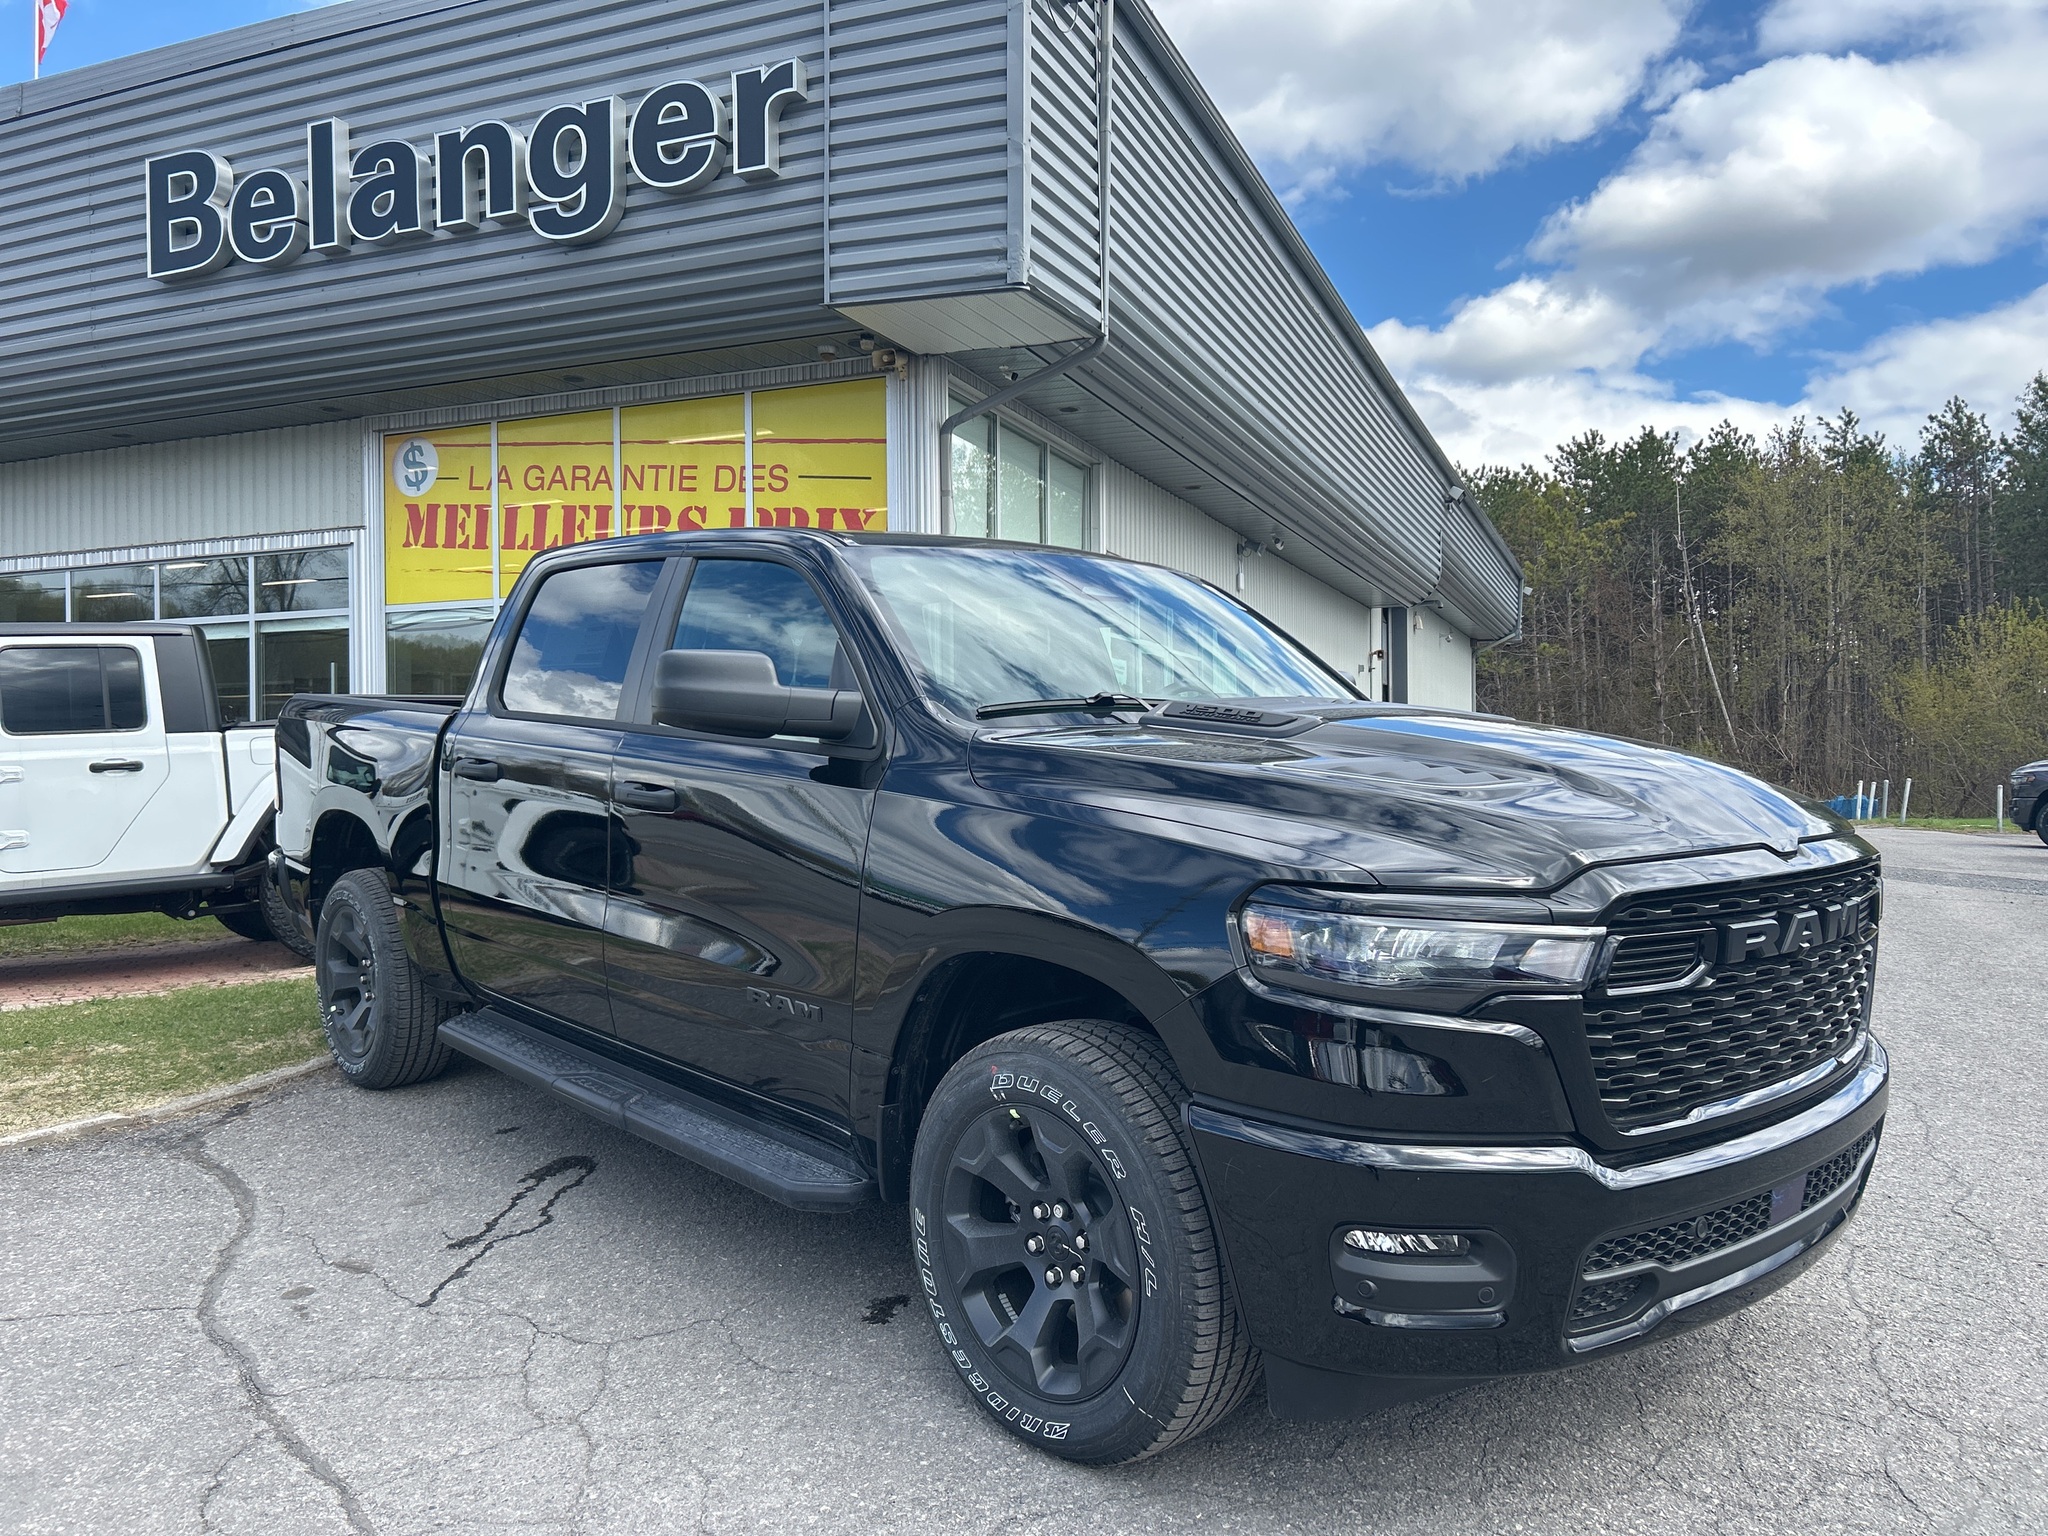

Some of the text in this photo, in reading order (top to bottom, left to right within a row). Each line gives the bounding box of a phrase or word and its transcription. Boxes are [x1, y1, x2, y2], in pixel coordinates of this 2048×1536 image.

[146, 56, 807, 282] Belanger
[469, 464, 789, 493] LA GARANTIE DES
[1727, 899, 1860, 964] RAM
[747, 986, 823, 1023] RAM
[991, 1073, 1127, 1181] DUELER
[914, 1207, 1071, 1440] BRIDGESTONE
